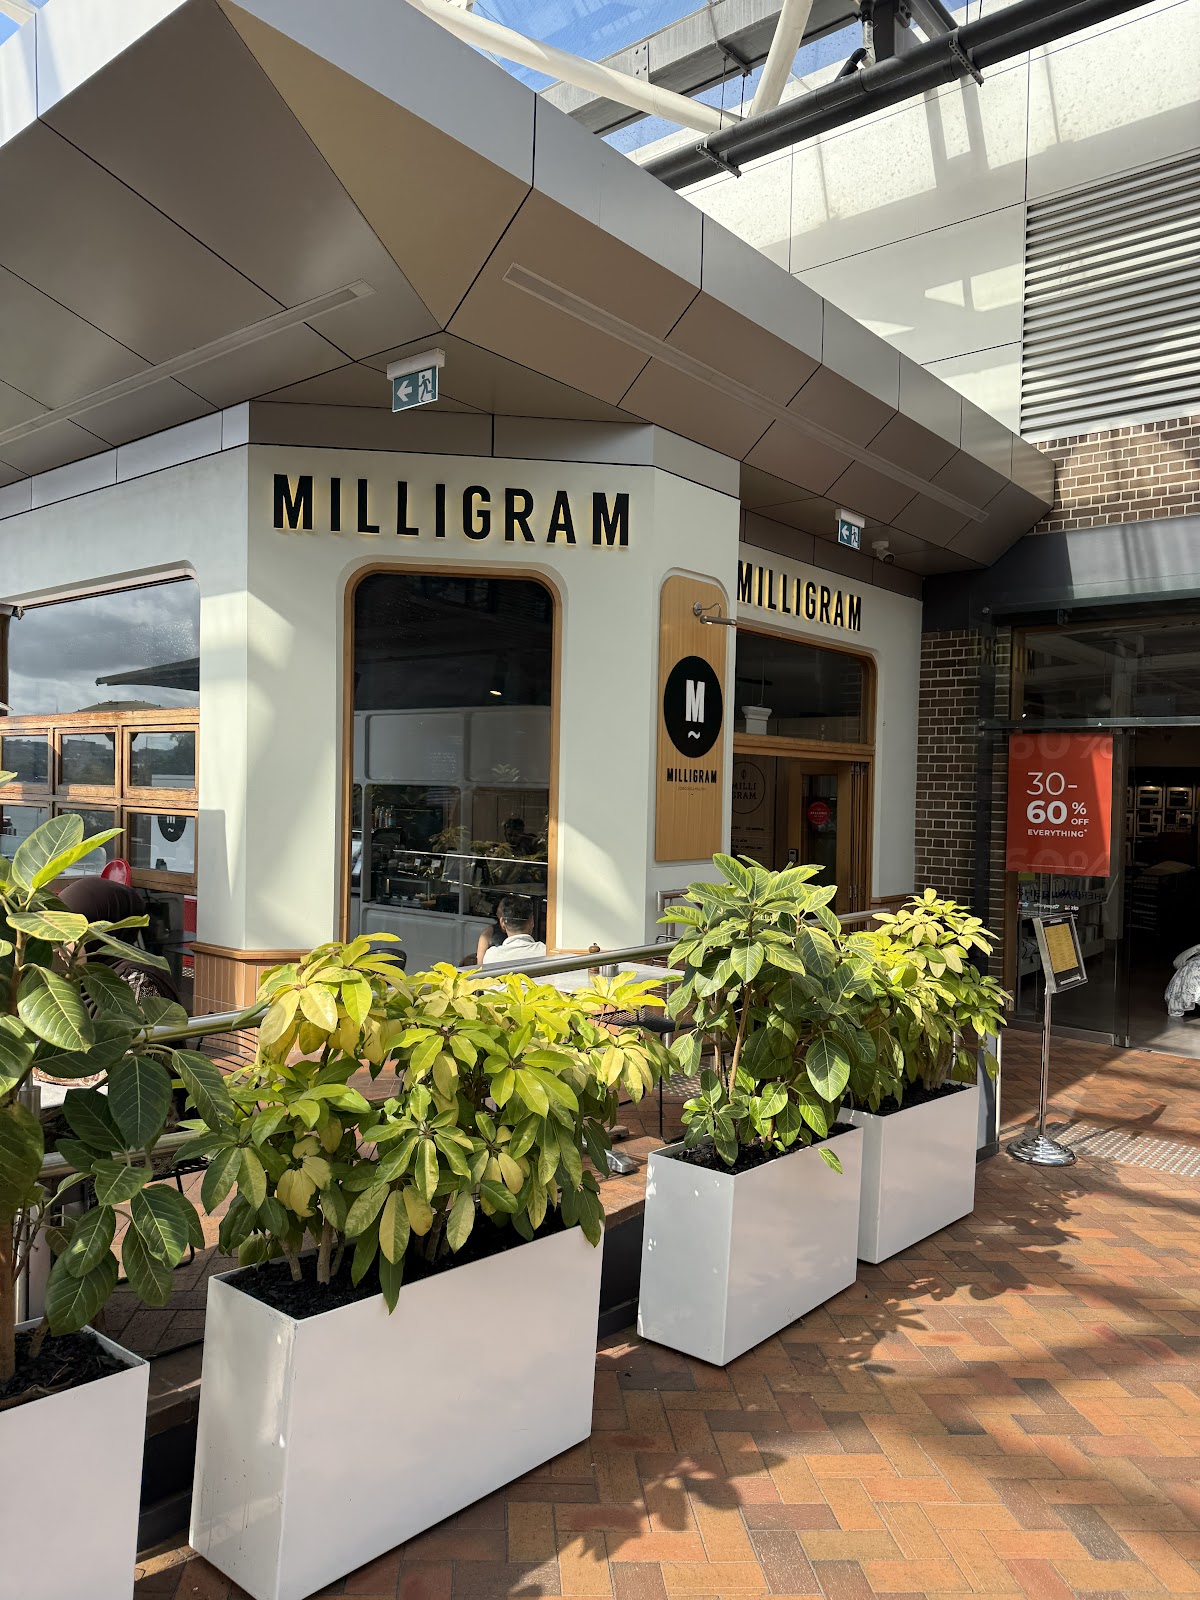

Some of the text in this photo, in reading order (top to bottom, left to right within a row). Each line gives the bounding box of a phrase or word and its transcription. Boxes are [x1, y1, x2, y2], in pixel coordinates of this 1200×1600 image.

[273, 473, 630, 547] MILLIGRAM
[737, 559, 862, 632] MILLIGRAM
[685, 679, 706, 723] M
[666, 767, 717, 784] MILLIGRAM
[1026, 771, 1078, 796] 30-
[1070, 817, 1090, 826] OFF
